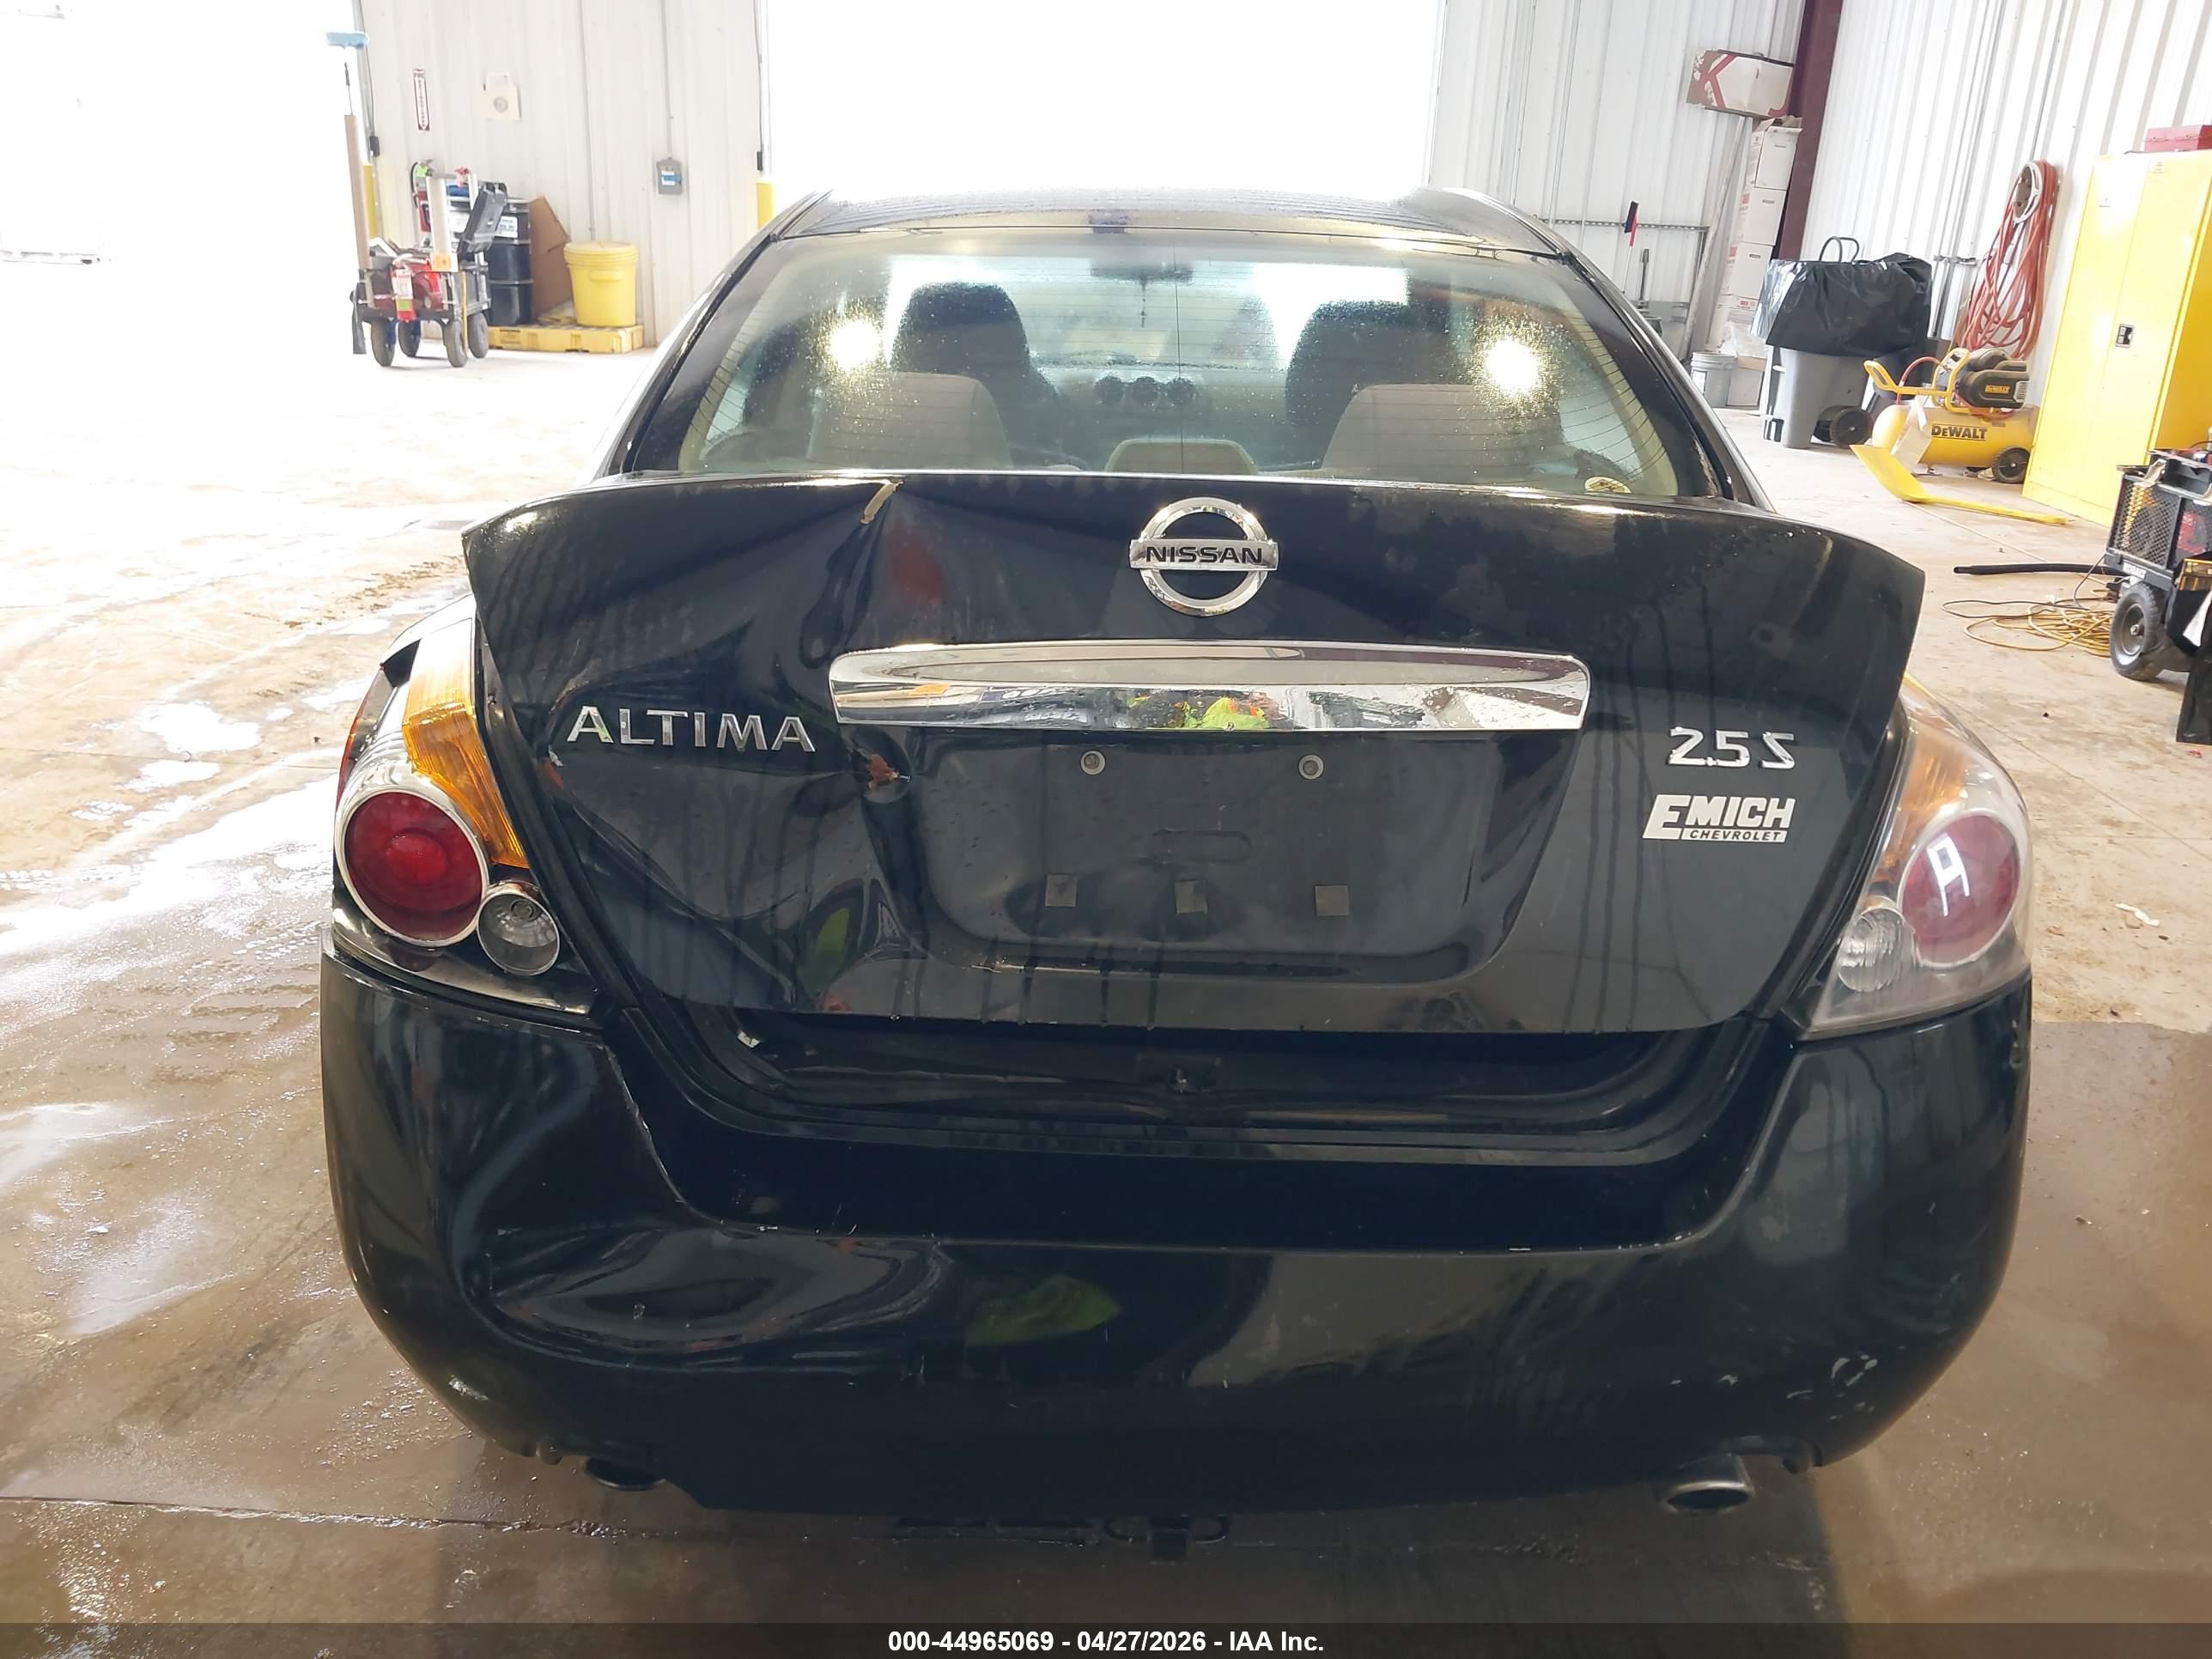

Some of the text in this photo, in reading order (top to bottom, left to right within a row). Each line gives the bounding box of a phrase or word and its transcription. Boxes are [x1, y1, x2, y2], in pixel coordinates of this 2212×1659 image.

[1931, 425, 1987, 440] DEWALT
[1146, 547, 1262, 564] NISSAN
[567, 706, 815, 752] ALTIMA
[1669, 726, 1796, 769] 2.5 S
[1643, 794, 1796, 840] EMICH
[1689, 830, 1781, 842] CHEVROLET
